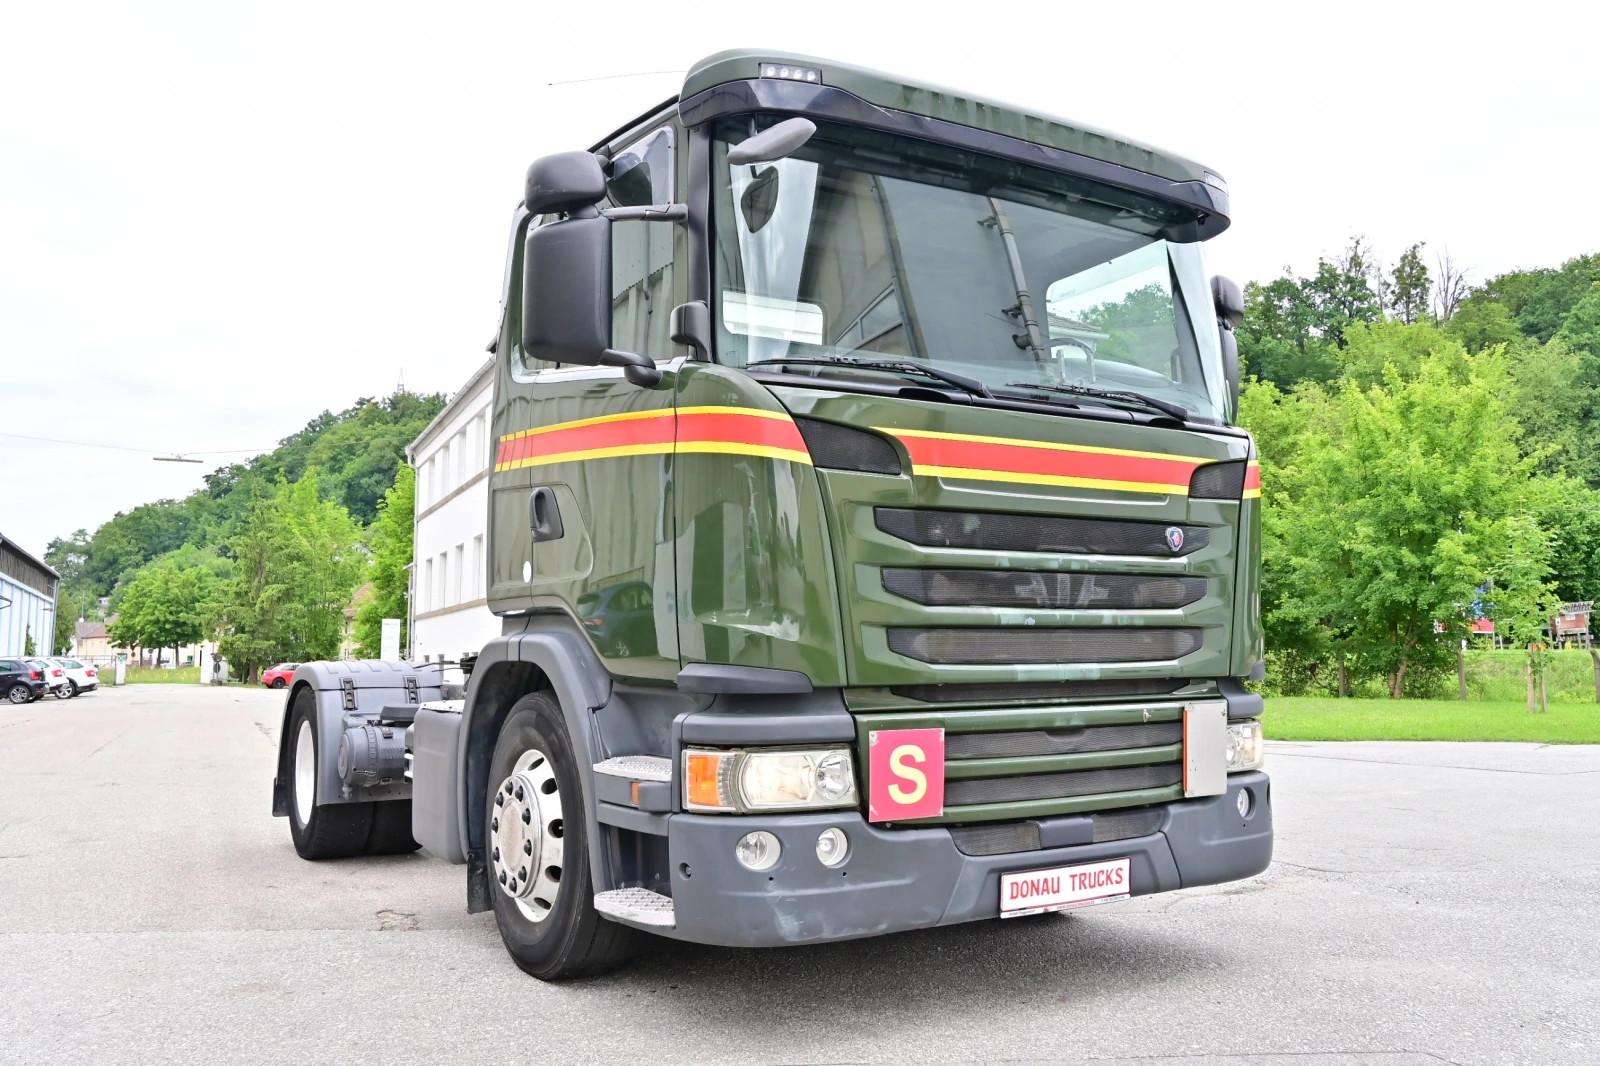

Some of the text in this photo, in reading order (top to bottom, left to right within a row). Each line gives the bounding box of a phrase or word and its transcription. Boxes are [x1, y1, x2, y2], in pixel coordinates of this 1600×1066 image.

[889, 744, 927, 804] S
[1010, 867, 1123, 900] DONAU TRUCKS
